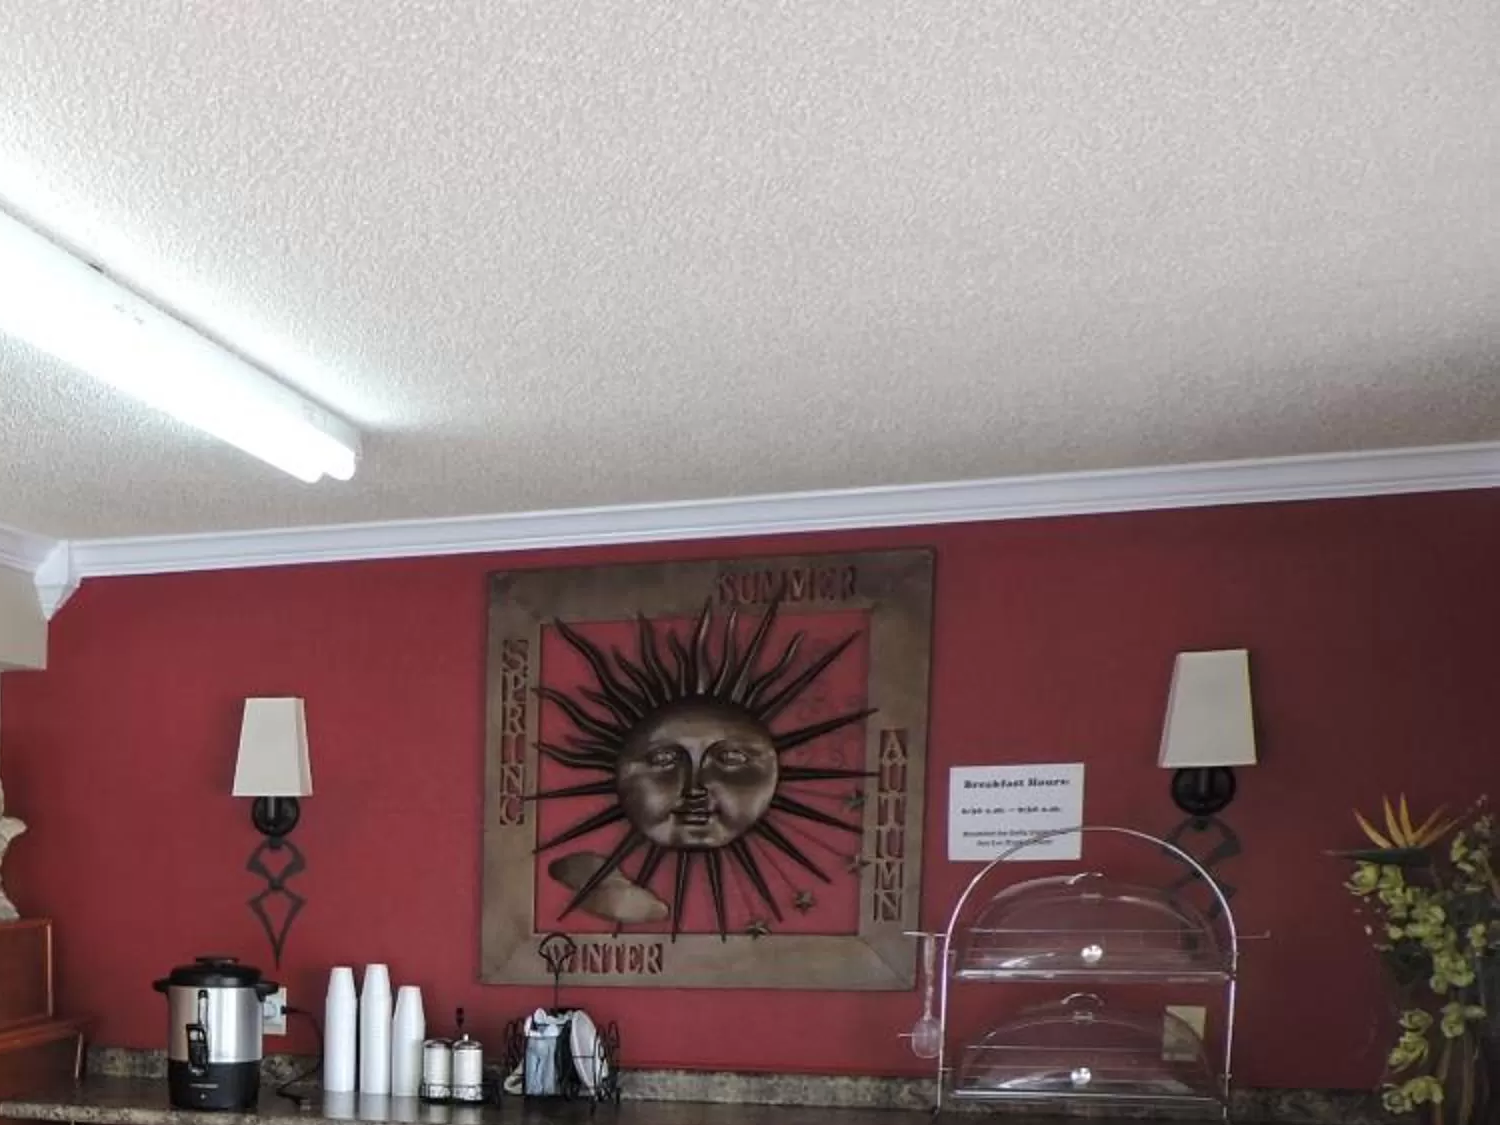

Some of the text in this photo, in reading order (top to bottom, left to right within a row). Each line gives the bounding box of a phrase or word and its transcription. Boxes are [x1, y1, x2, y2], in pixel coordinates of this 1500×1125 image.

[717, 565, 857, 603] SUMMER
[500, 639, 529, 825] SPRING
[963, 780, 1025, 789] Breakfast
[874, 729, 907, 921] AUTUMN
[546, 943, 662, 974] WINTER
